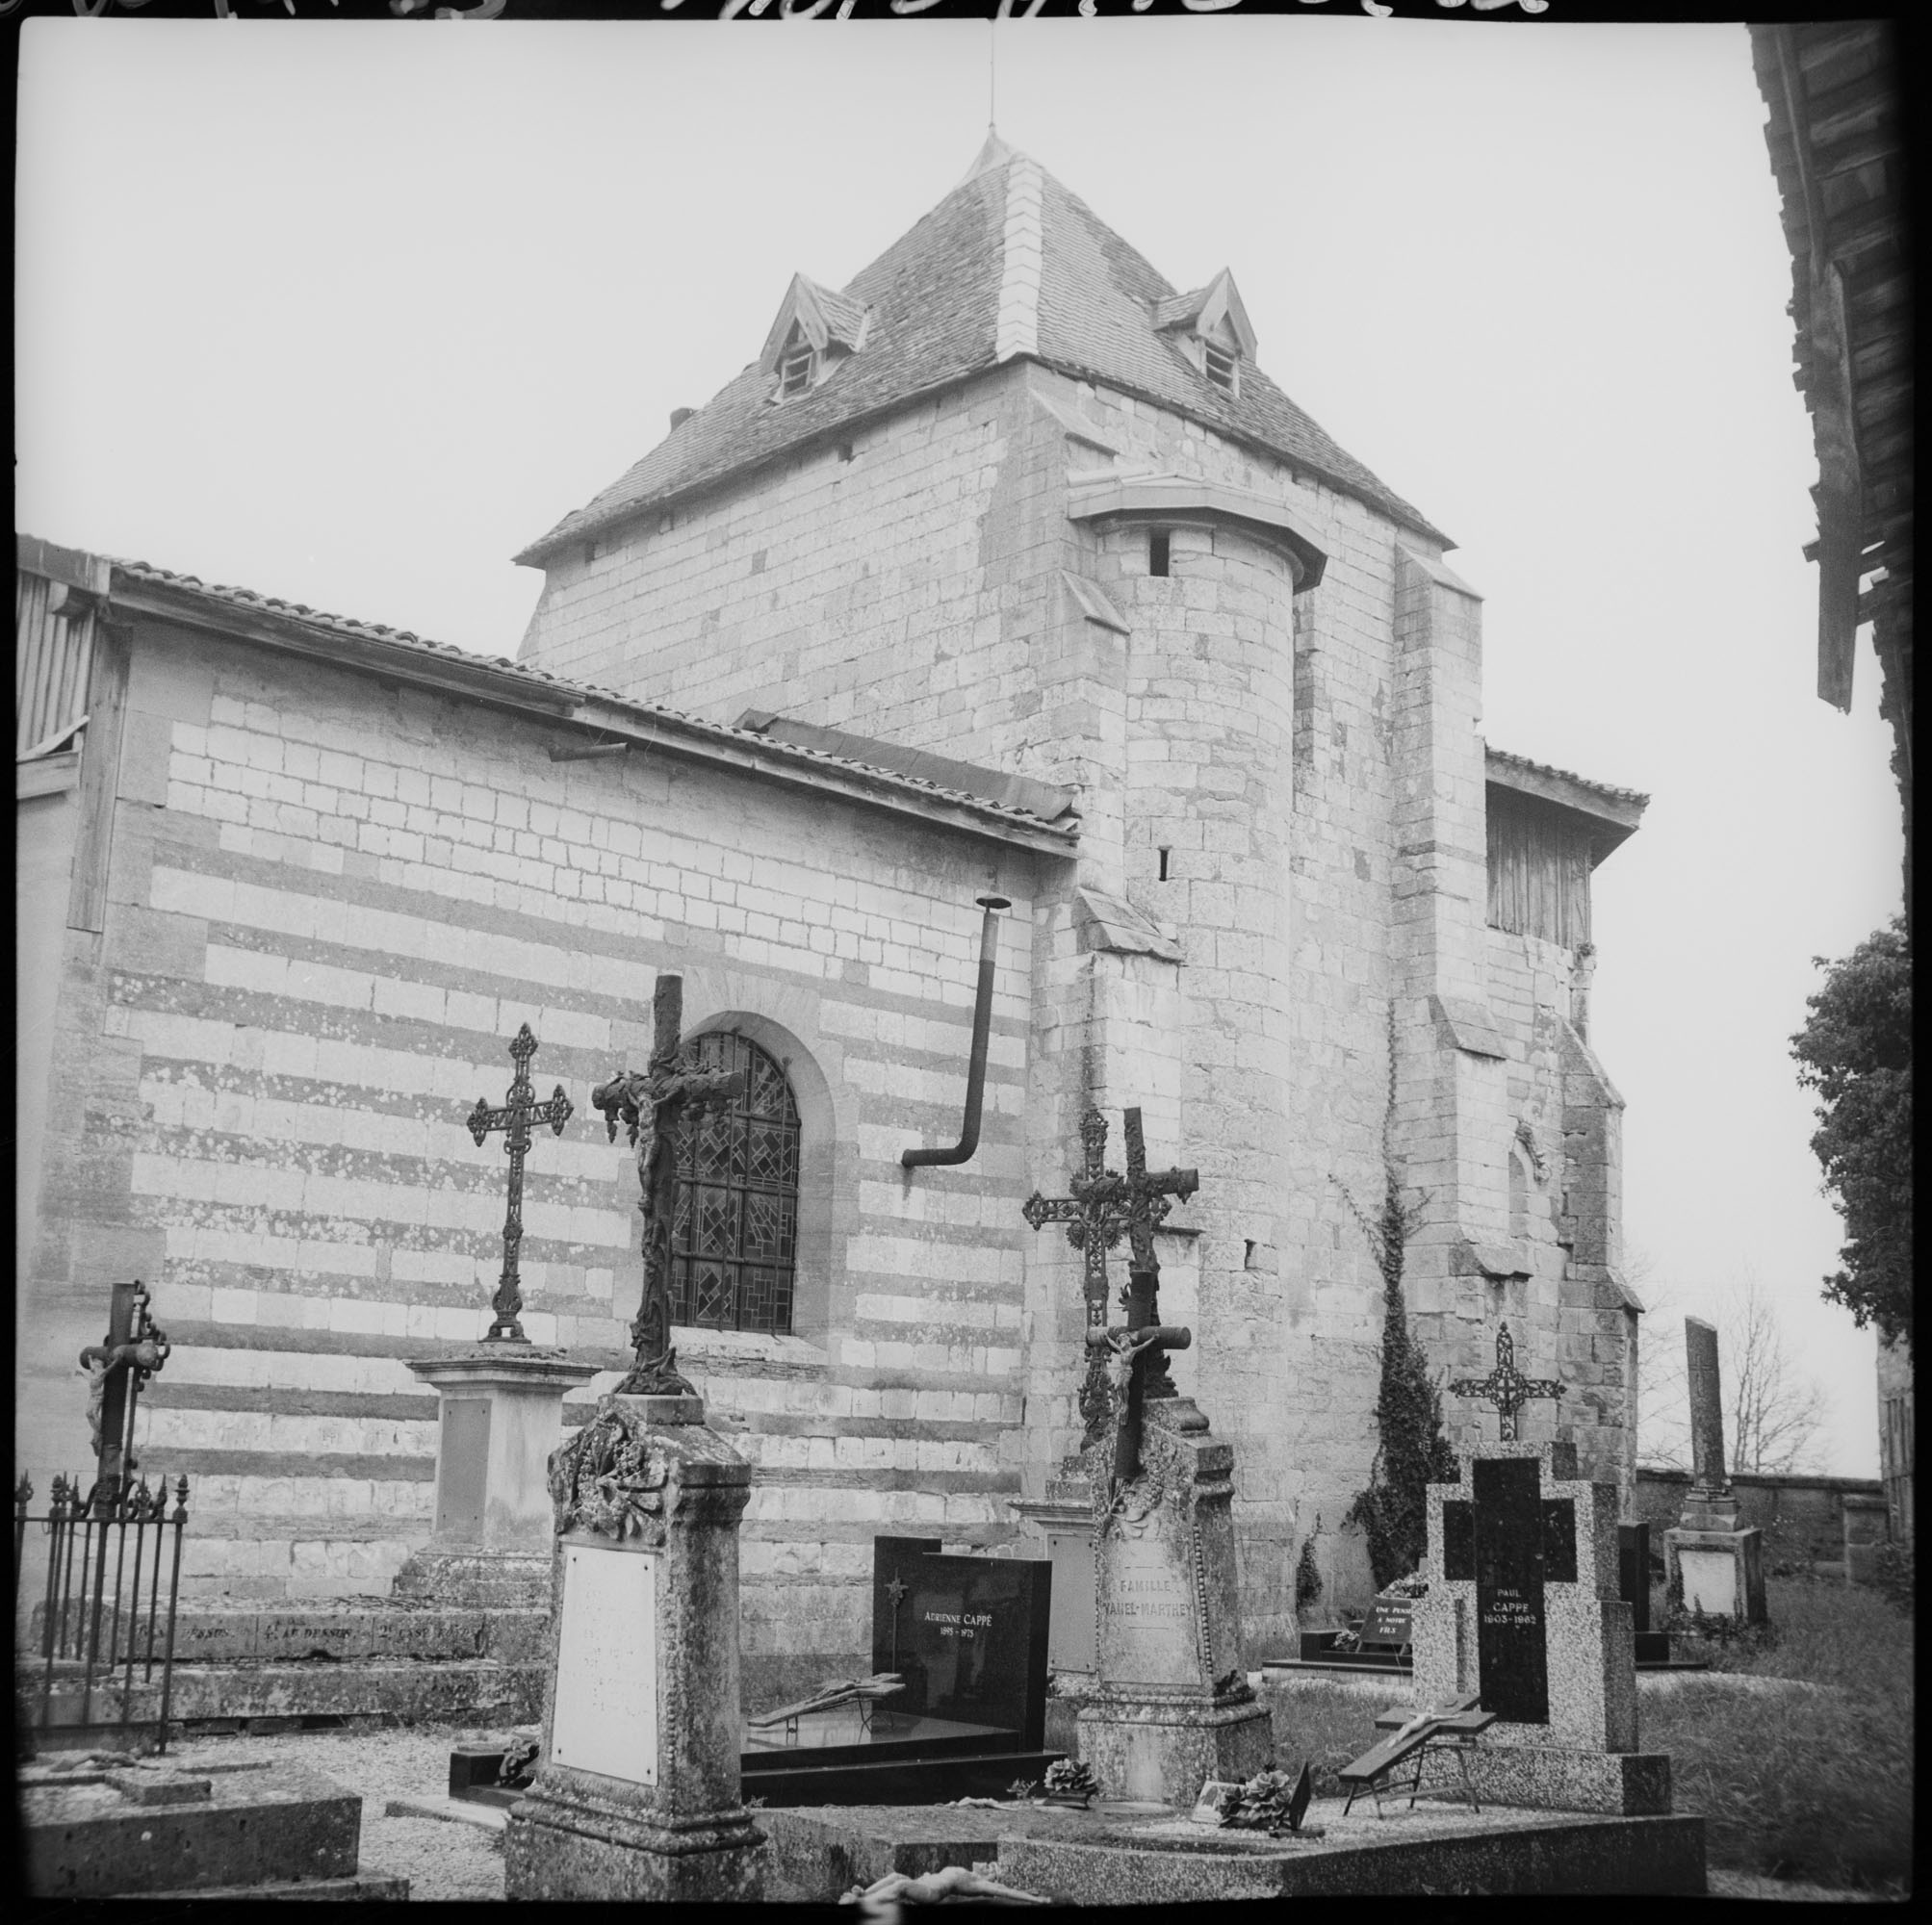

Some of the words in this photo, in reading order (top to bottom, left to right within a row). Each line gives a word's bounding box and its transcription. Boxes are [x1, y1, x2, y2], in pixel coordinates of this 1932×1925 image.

[1121, 1579, 1172, 1593] FAMILLE
[1497, 1588, 1522, 1598] PAUL
[924, 1611, 962, 1624] ADRIENNE
[963, 1613, 992, 1627] CAPPÉ
[1379, 1626, 1397, 1634] FILS
